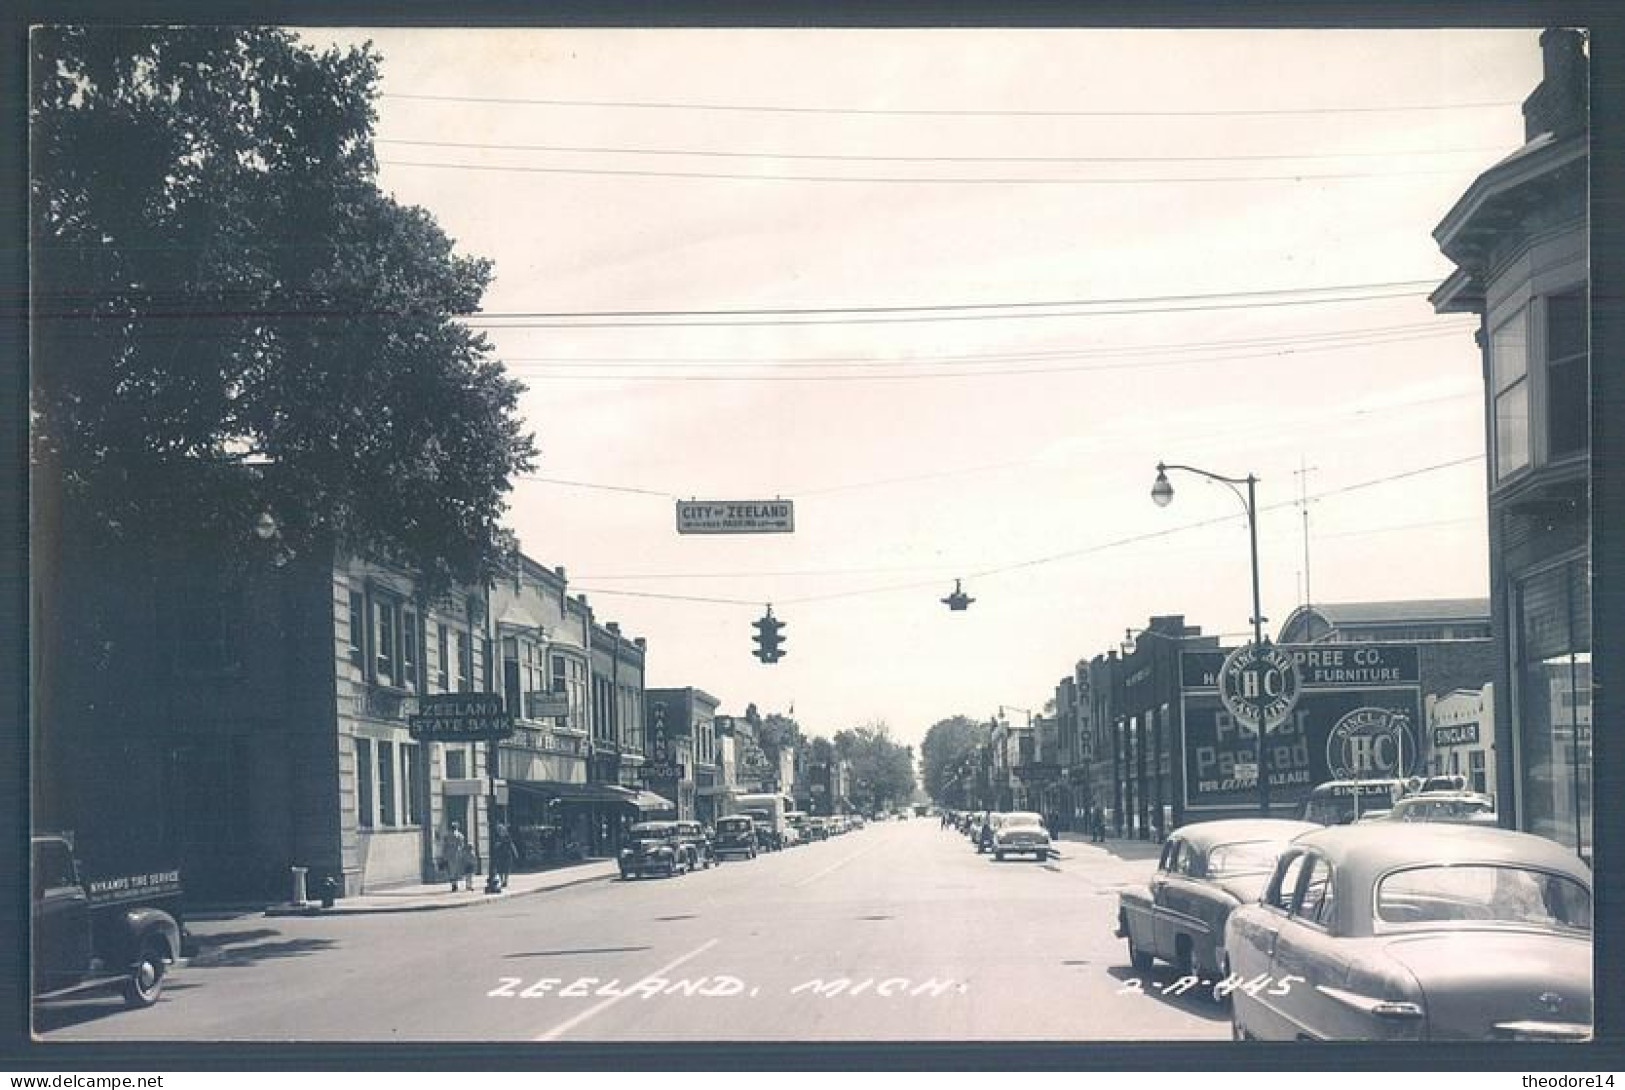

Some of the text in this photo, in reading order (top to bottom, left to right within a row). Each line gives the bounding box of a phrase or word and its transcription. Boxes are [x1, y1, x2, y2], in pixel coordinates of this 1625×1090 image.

[682, 505, 712, 519] CITY
[727, 505, 788, 518] ZEELAND
[1353, 649, 1385, 666] CO.
[1314, 668, 1400, 683] FURNITURE
[422, 702, 498, 717] ZEELAND
[411, 717, 511, 733] STATE BANK
